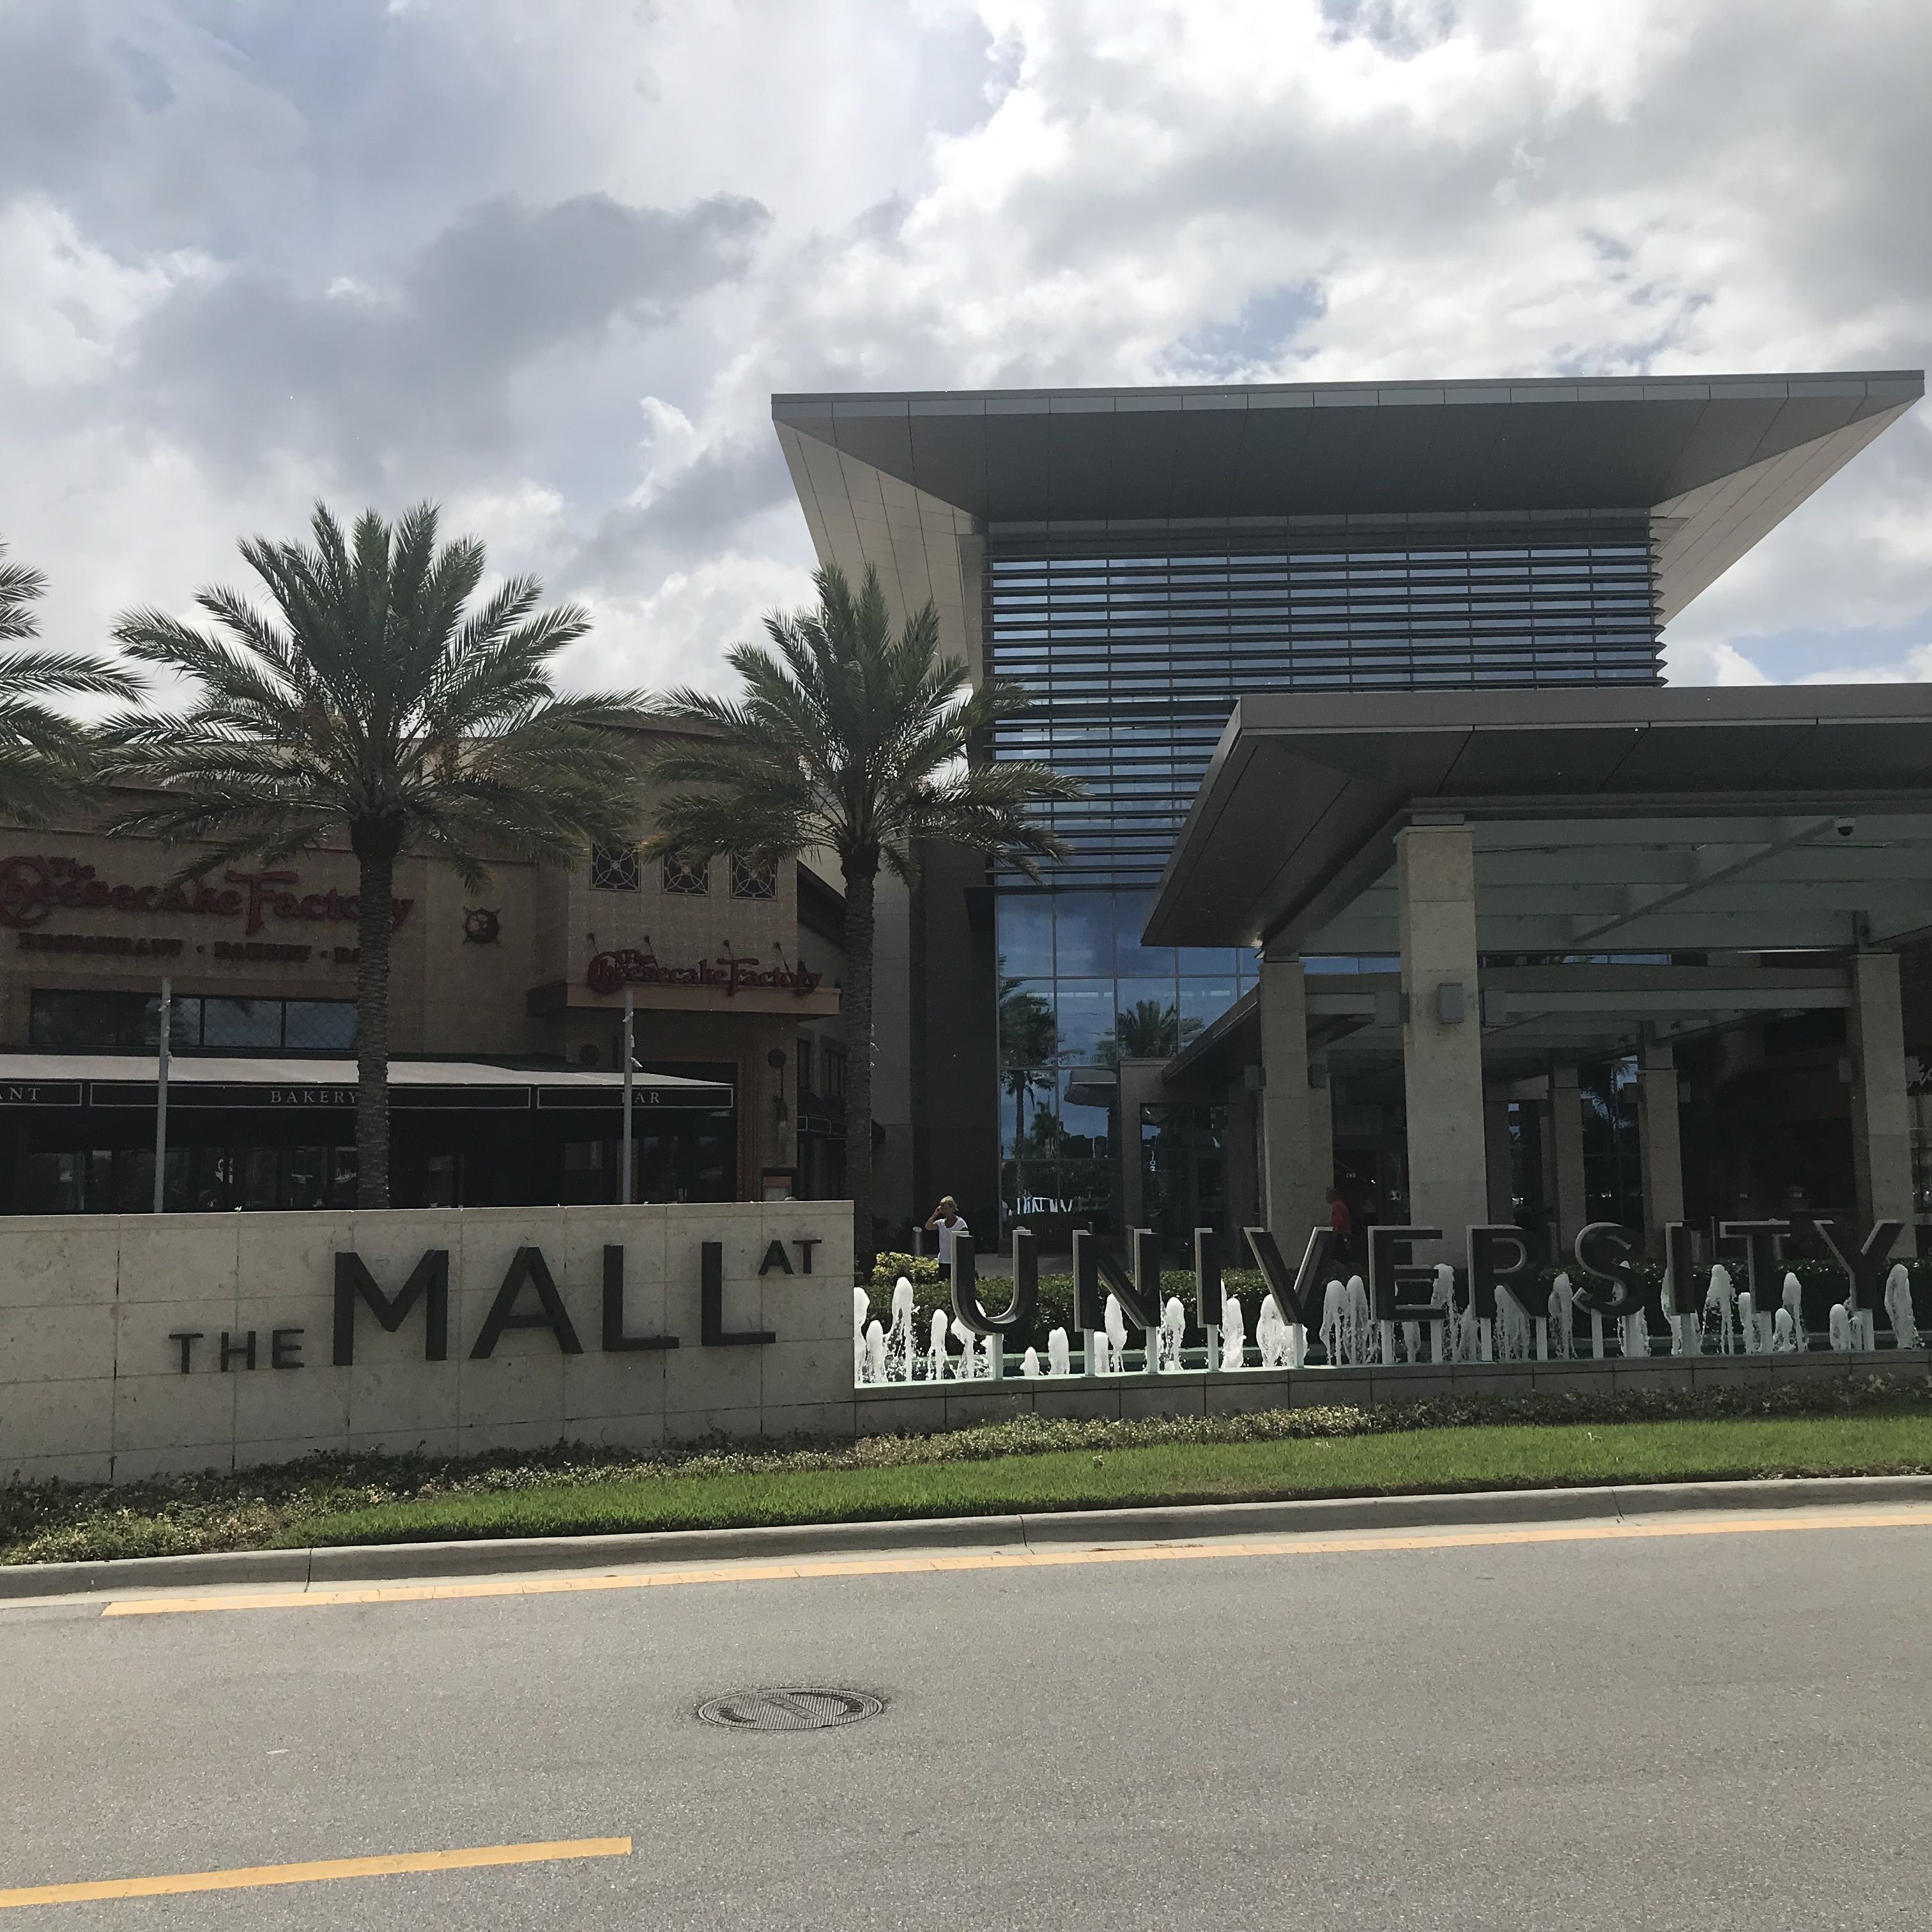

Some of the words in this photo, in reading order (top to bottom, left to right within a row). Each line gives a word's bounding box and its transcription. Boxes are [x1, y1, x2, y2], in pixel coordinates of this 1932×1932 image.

[225, 870, 414, 935] Factoy
[716, 958, 823, 997] Factory
[0, 1087, 41, 1100] NT
[271, 1091, 358, 1103] BAKERY
[951, 1219, 1905, 1335] UNIVERSITY
[169, 1329, 305, 1374] THE
[333, 1241, 776, 1367] MALL
[758, 1238, 822, 1276] AT
